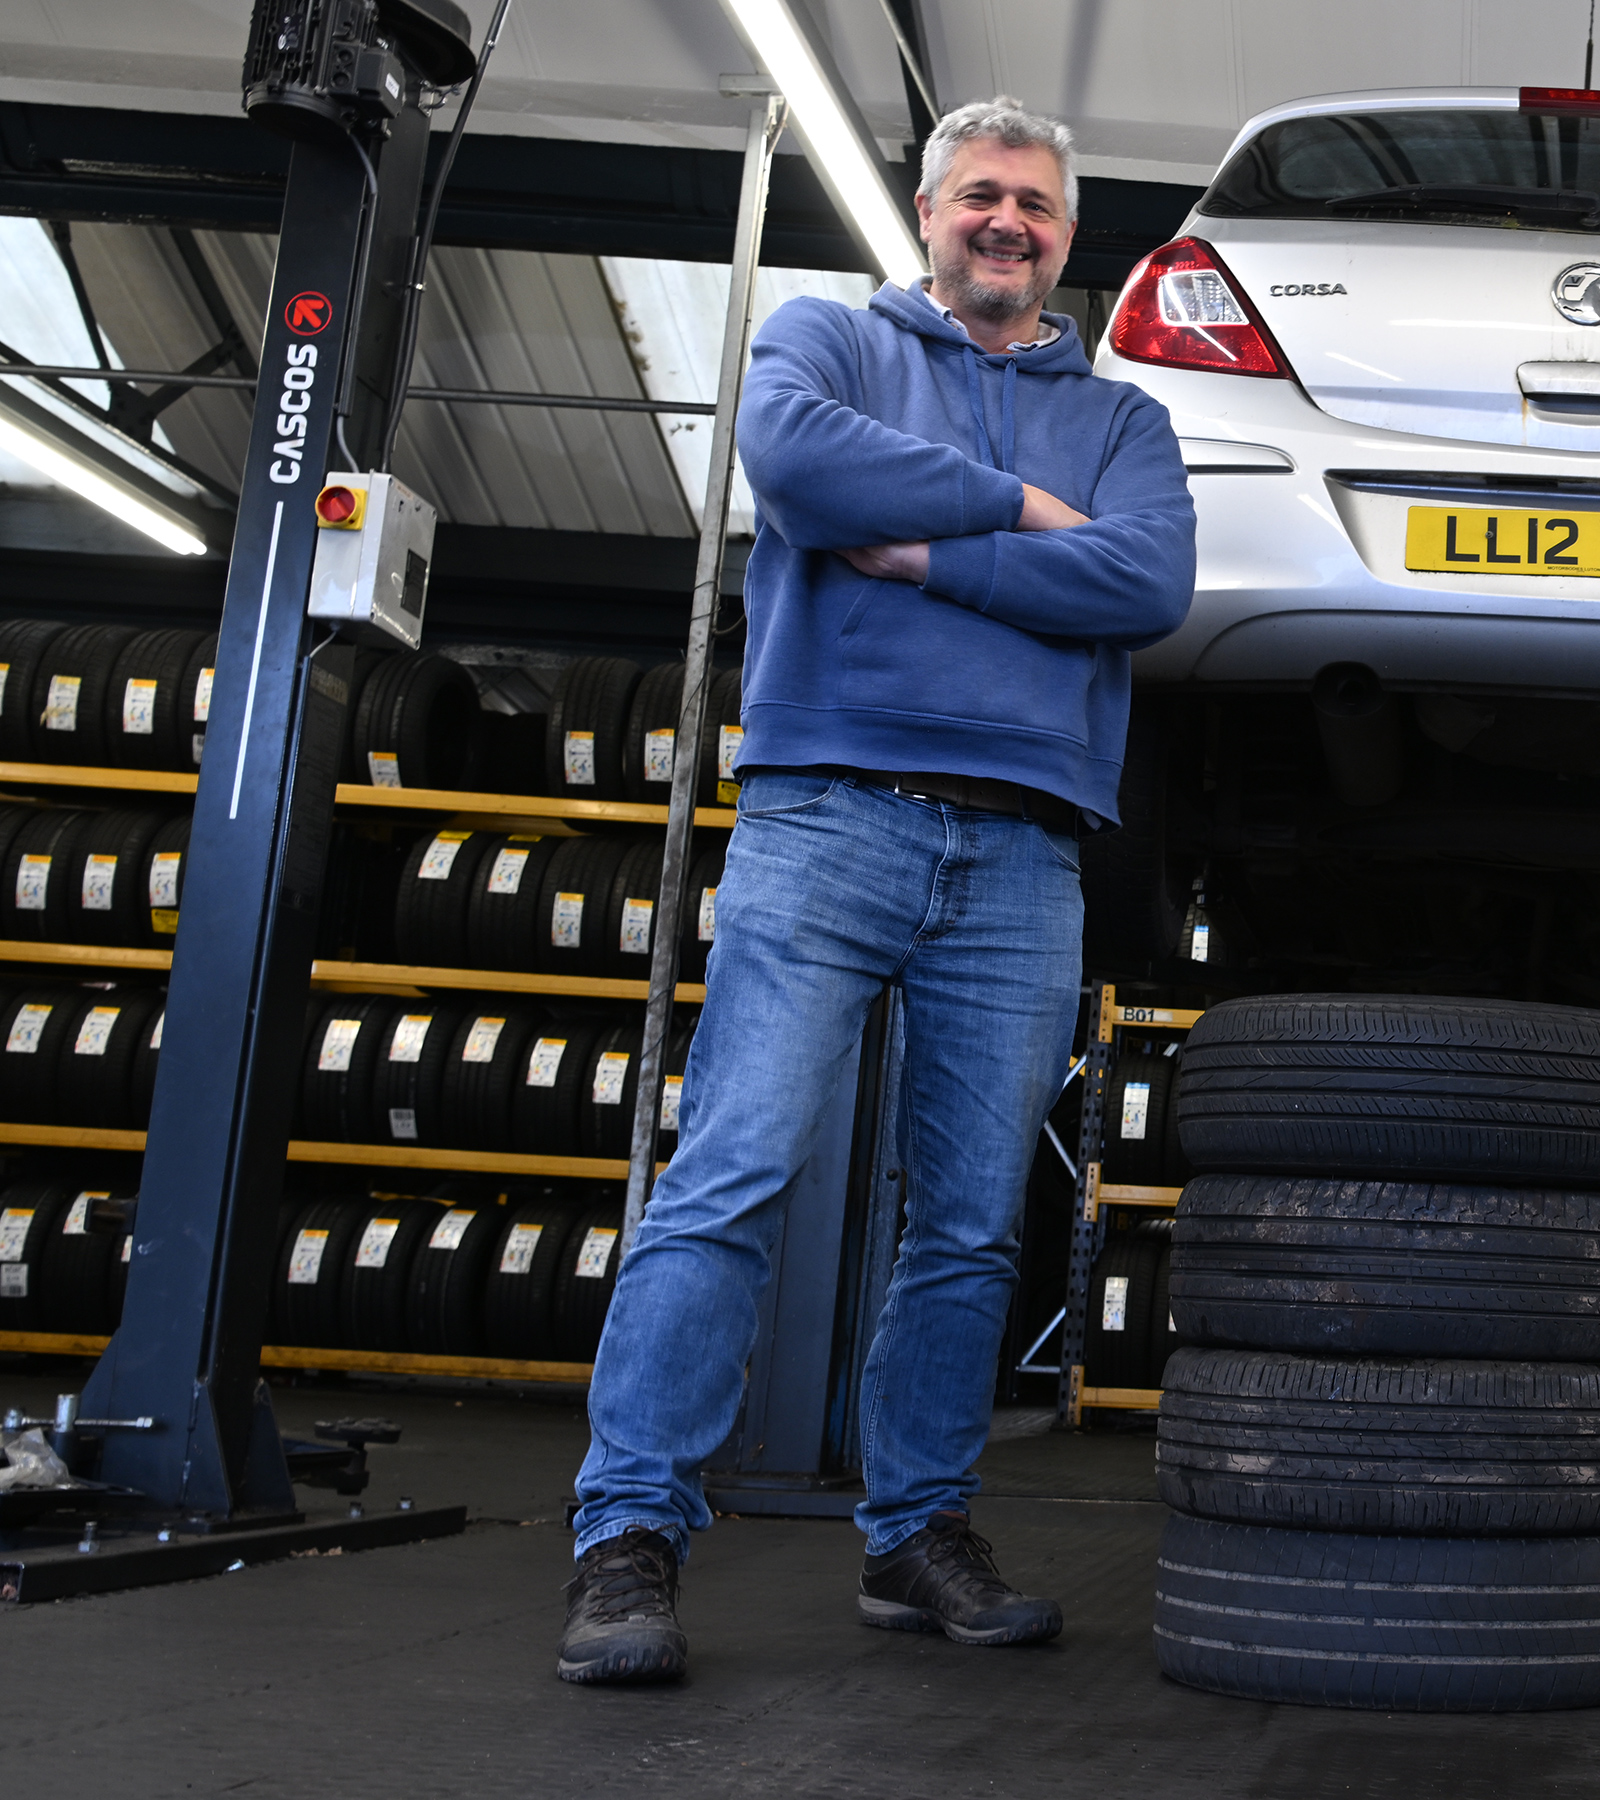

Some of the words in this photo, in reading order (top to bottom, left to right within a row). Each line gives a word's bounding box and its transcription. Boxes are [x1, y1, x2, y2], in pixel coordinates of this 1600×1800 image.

[1270, 283, 1348, 297] CORSA
[269, 343, 318, 485] CASCOS
[1445, 515, 1579, 565] LL12
[1124, 1007, 1155, 1023] B01
